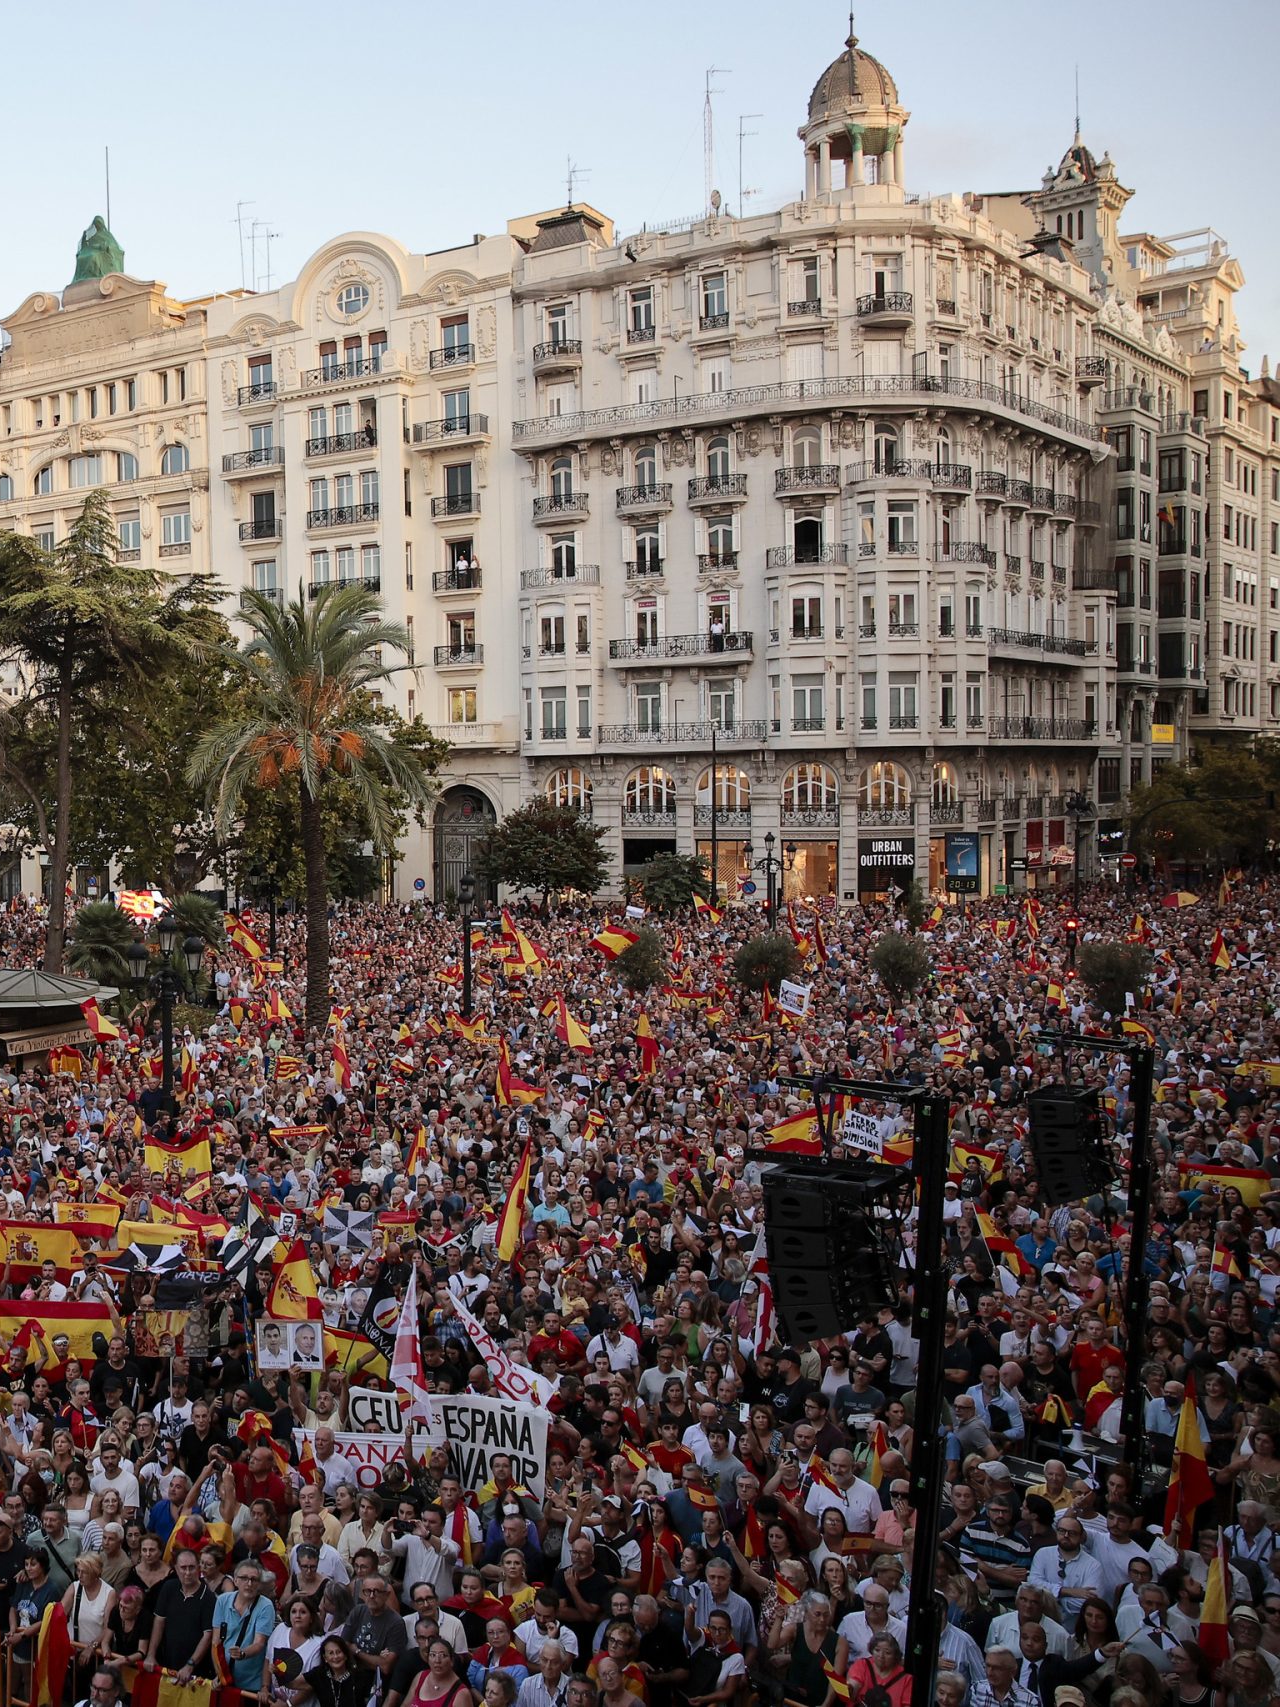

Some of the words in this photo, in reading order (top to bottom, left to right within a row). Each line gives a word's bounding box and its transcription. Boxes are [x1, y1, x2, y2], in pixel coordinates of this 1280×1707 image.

[872, 841, 902, 852] URBAN
[860, 854, 914, 866] OUTFITTERS
[949, 881, 976, 889] 20:13
[851, 1113, 876, 1130] PERRO
[845, 1120, 879, 1138] SANCHEZ
[351, 1396, 431, 1435] CEU
[442, 1404, 534, 1456] ESPAÑA
